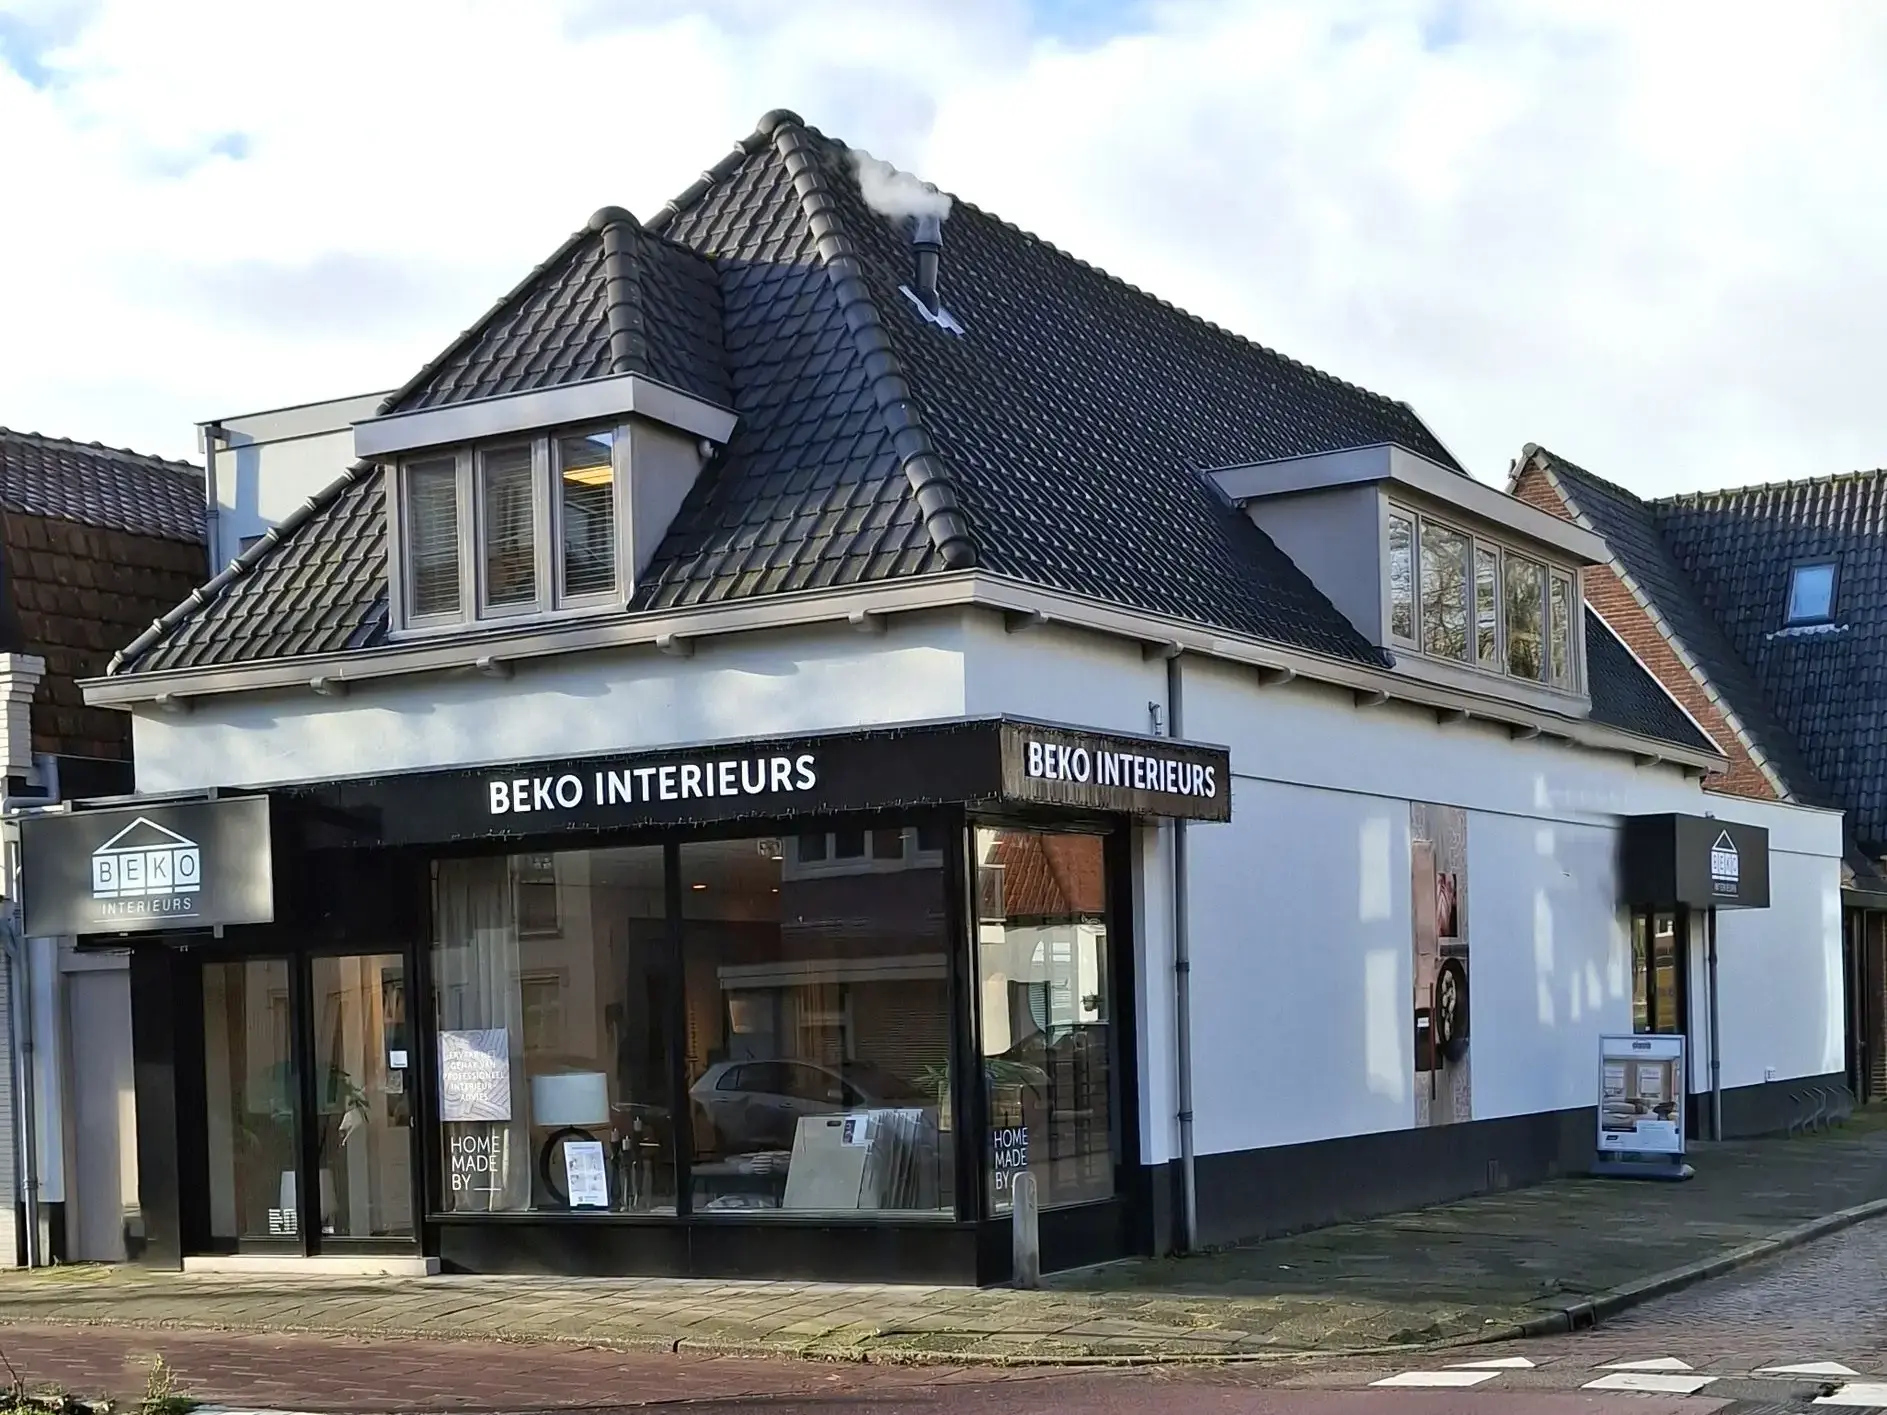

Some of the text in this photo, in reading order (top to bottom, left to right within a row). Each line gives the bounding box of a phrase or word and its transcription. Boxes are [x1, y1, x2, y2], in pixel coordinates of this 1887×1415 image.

[1028, 741, 1216, 798] BEKO INTERIEURS
[489, 754, 817, 815] BEKO INTERIEURS
[99, 854, 195, 883] BEKO
[102, 897, 192, 915] INTERIEURS
[450, 1135, 501, 1153] HOME
[994, 1127, 1029, 1149] HOME
[451, 1154, 498, 1172] MADE
[995, 1148, 1028, 1170] MADE
[451, 1173, 472, 1191] BY
[995, 1170, 1010, 1190] BY
